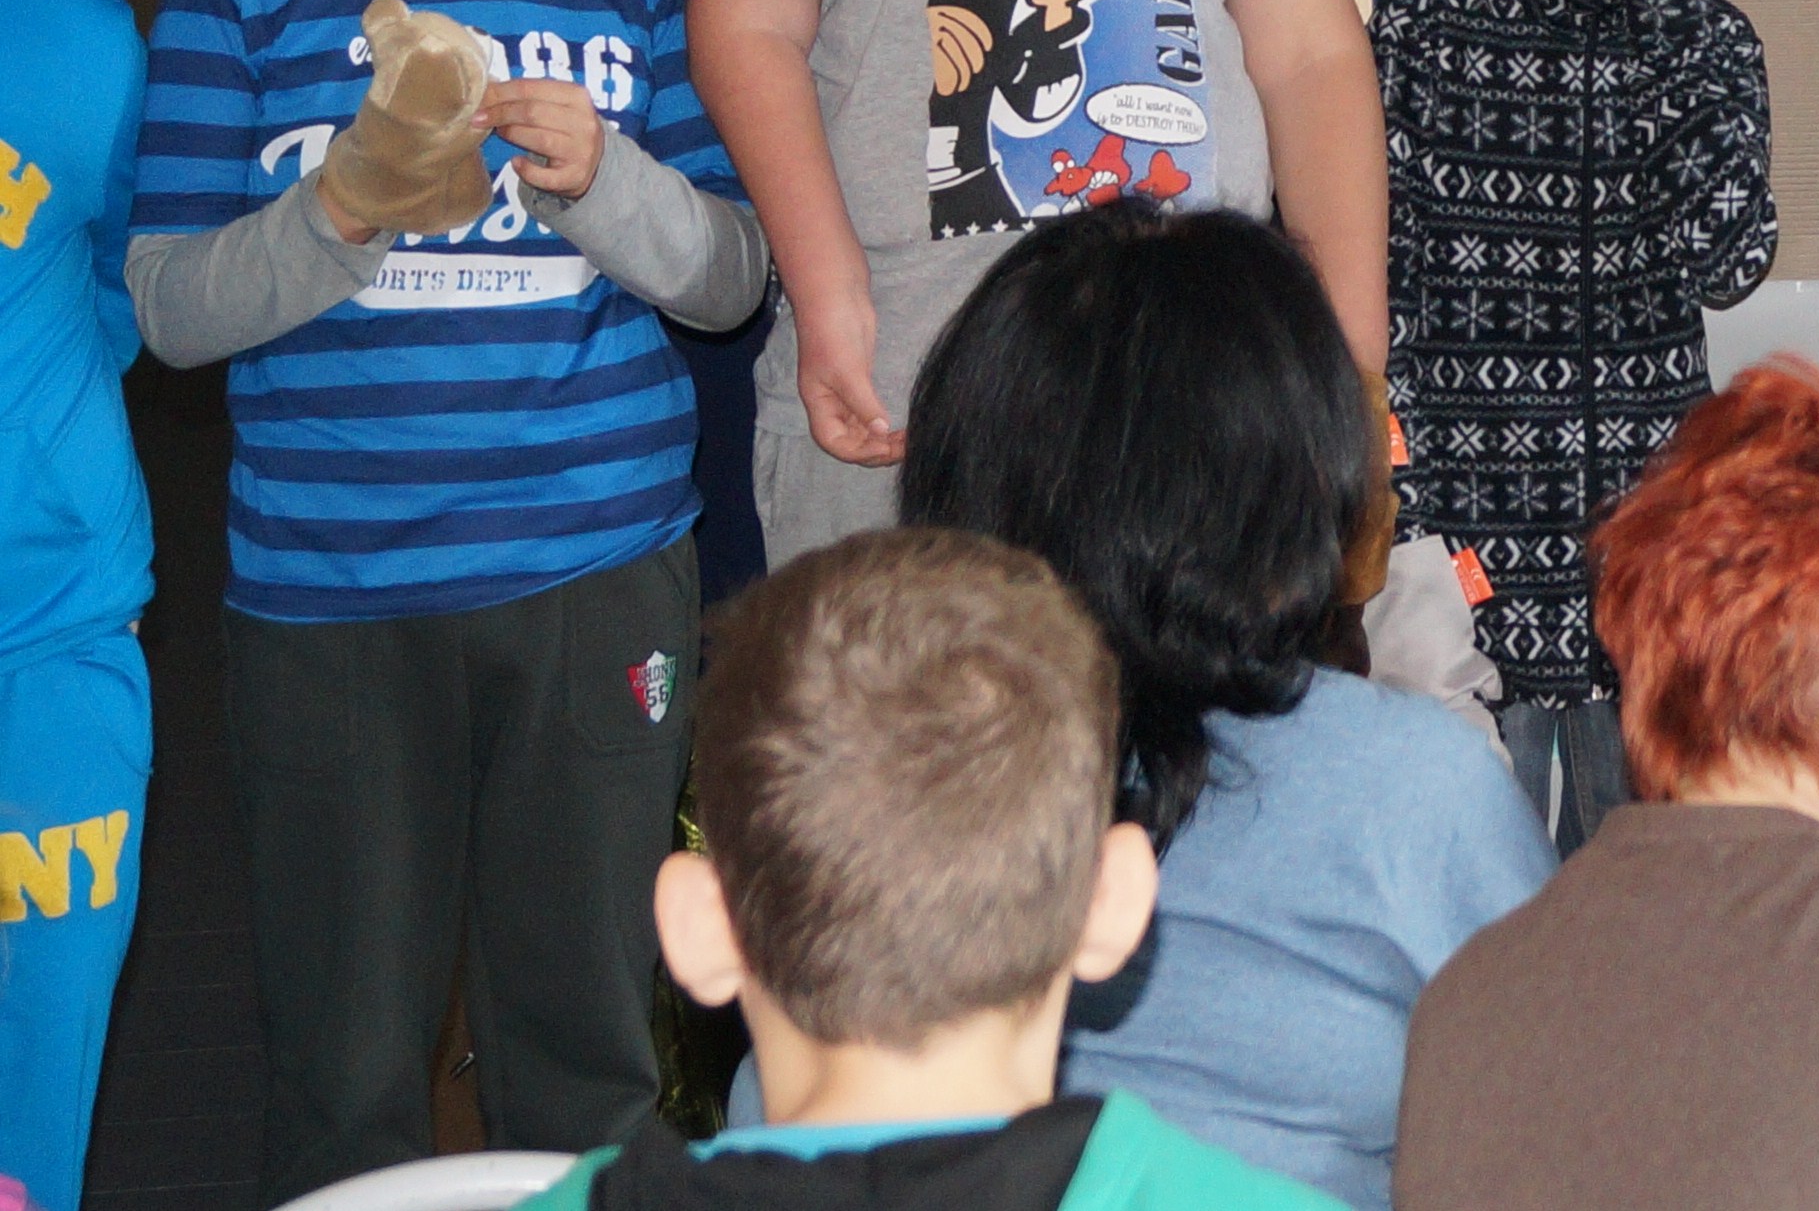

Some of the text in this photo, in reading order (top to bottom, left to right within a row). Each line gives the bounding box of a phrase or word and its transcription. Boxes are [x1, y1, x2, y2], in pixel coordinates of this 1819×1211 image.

[490, 30, 634, 112] 86
[1145, 100, 1173, 114] want
[1109, 113, 1122, 125] to
[1126, 113, 1174, 131] DESTROY
[371, 268, 541, 293] ORTS DEPT.
[646, 684, 670, 708] 56
